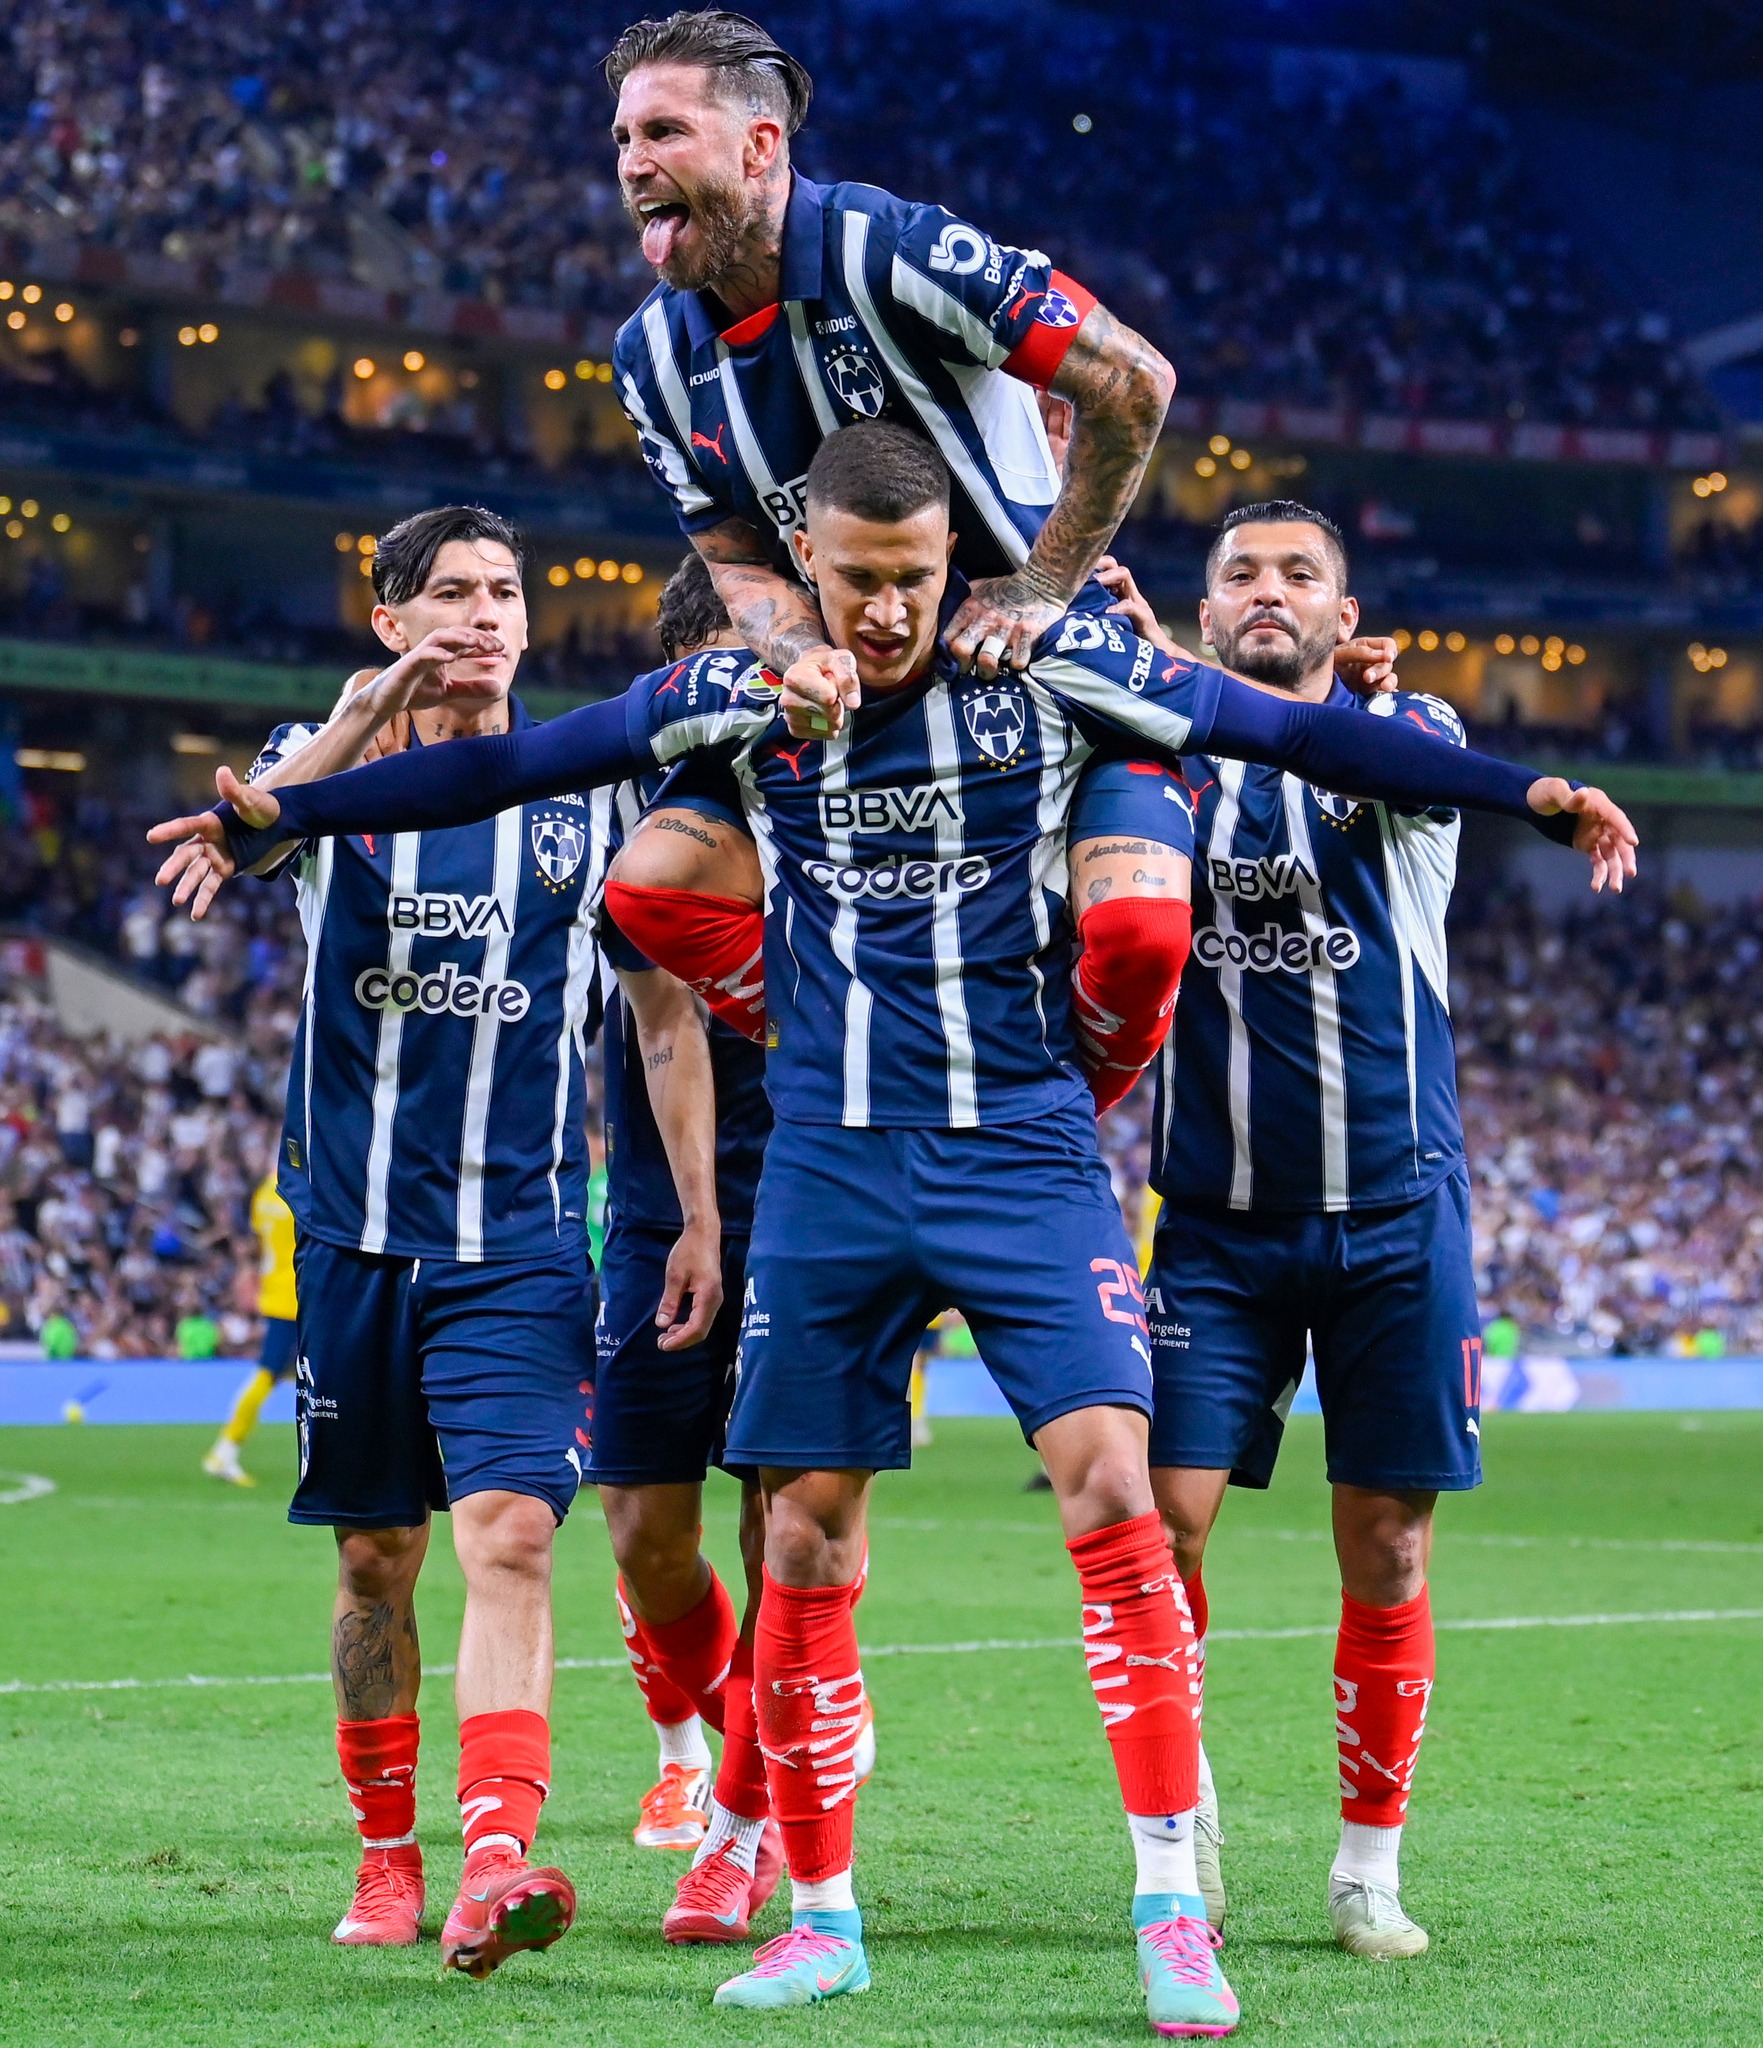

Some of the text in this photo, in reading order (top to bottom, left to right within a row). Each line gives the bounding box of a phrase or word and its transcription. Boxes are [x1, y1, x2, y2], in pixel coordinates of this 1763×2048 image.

[1128, 637, 1155, 693] CRES
[823, 786, 960, 829] BBVA
[655, 817, 717, 849] Mucho
[806, 856, 986, 896] codere
[1210, 854, 1317, 897] BBVA
[392, 895, 511, 934] BBVA
[1196, 925, 1355, 969] codere
[360, 967, 526, 1018] codere
[648, 1045, 674, 1072] 1961
[1148, 1321, 1192, 1337] Angeles
[1158, 1338, 1190, 1350] ORIENTE
[1461, 1336, 1482, 1408] 17
